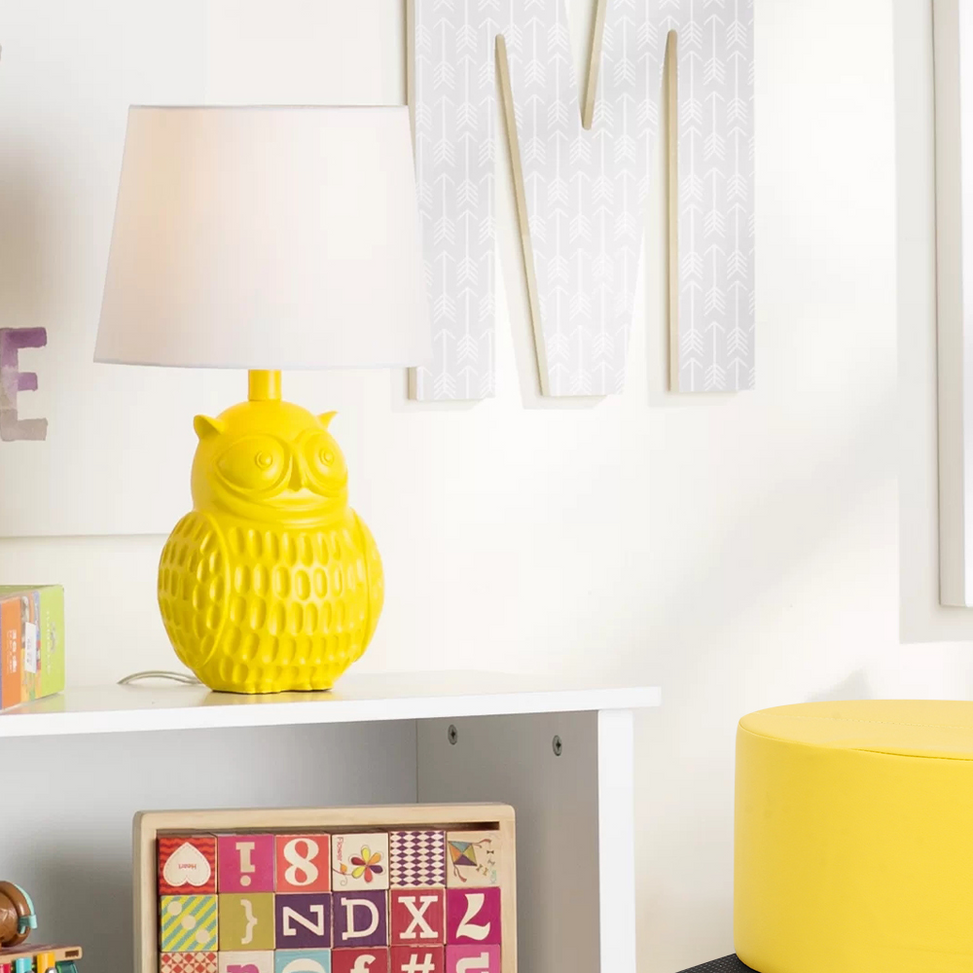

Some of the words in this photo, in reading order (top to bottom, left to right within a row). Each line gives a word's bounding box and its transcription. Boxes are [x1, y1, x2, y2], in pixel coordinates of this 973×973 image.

[283, 838, 319, 886] 8
[340, 897, 379, 941] D
[398, 895, 438, 939] X
